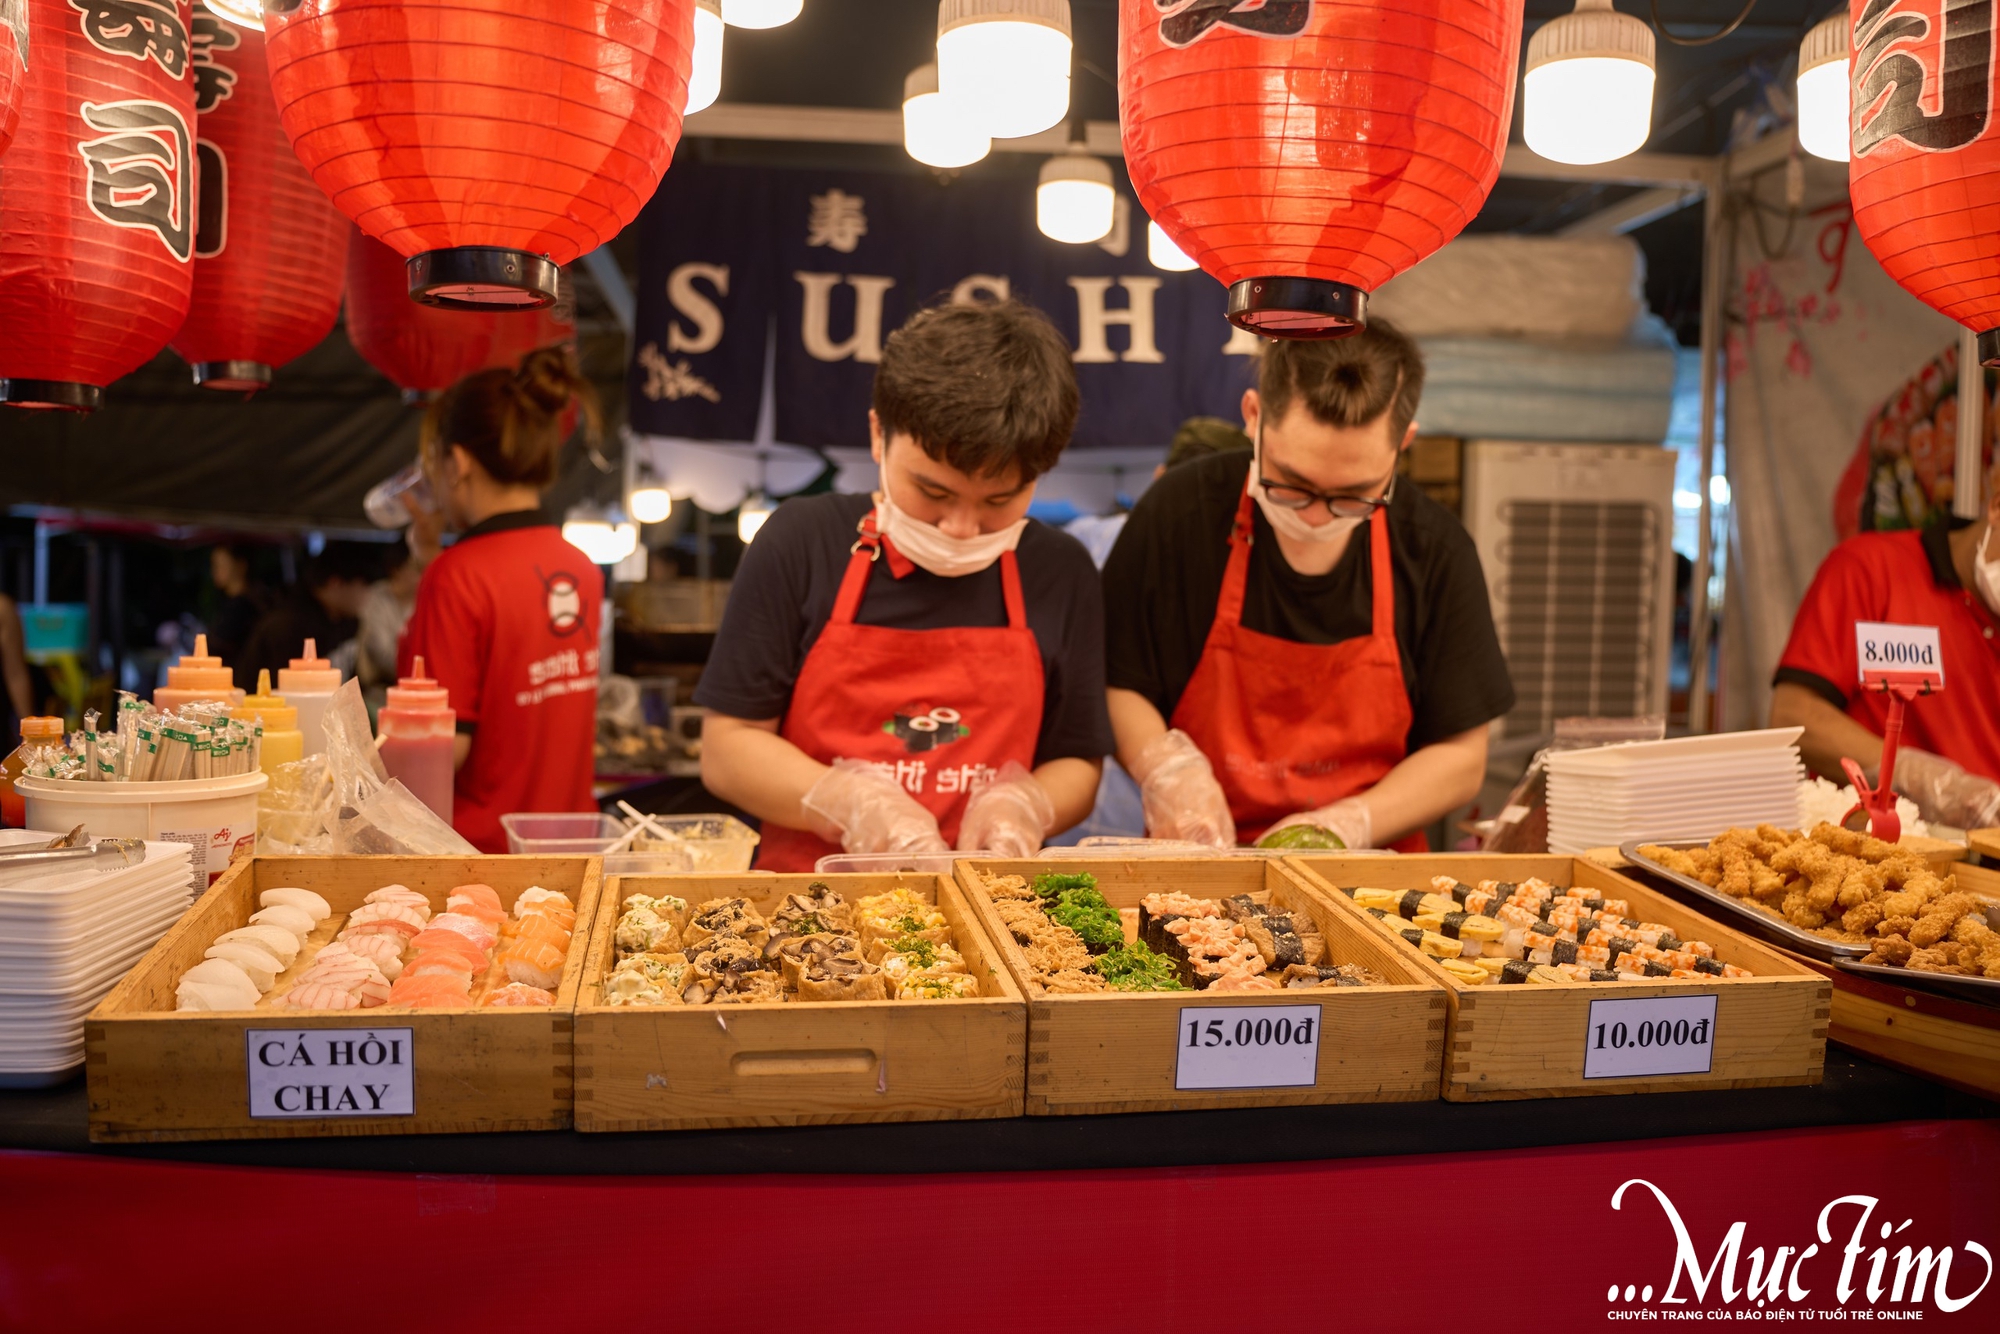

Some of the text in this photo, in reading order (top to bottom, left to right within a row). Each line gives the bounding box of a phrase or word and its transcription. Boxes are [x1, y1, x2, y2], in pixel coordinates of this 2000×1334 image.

[1185, 1017, 1315, 1048] 15.000đ
[1593, 1018, 1711, 1050] 10.000đ
[258, 1032, 403, 1068] CÁ HỒI
[274, 1084, 391, 1112] CHAY
